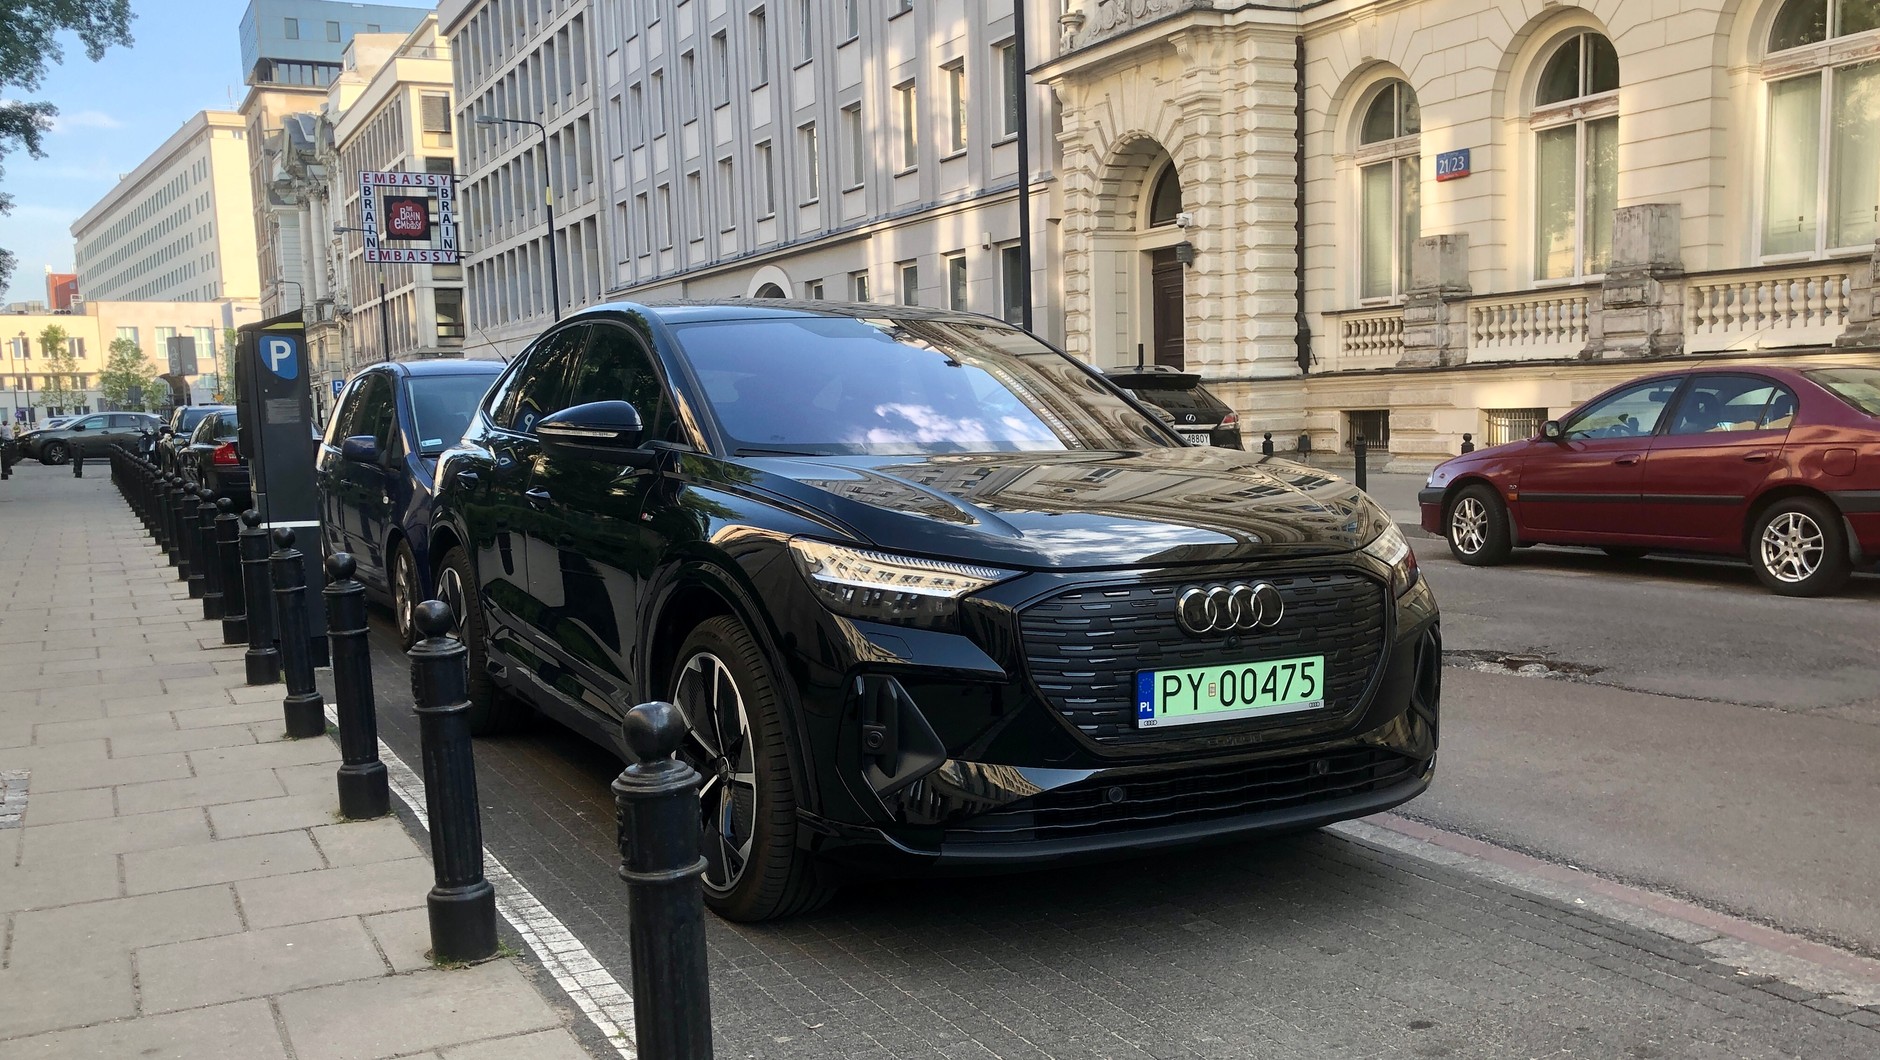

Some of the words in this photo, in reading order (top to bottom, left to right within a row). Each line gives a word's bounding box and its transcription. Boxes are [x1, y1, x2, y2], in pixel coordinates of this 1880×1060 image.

[1439, 156, 1465, 174] 21/23
[363, 173, 448, 185] EMBASSY
[363, 186, 376, 248] BRAIN
[441, 189, 453, 249] BRAIN
[368, 250, 453, 261] EMBASSY
[269, 340, 292, 372] P
[335, 381, 343, 392] P
[1162, 672, 1206, 714] PY
[1220, 661, 1315, 707] 00475
[1140, 701, 1153, 712] PL
